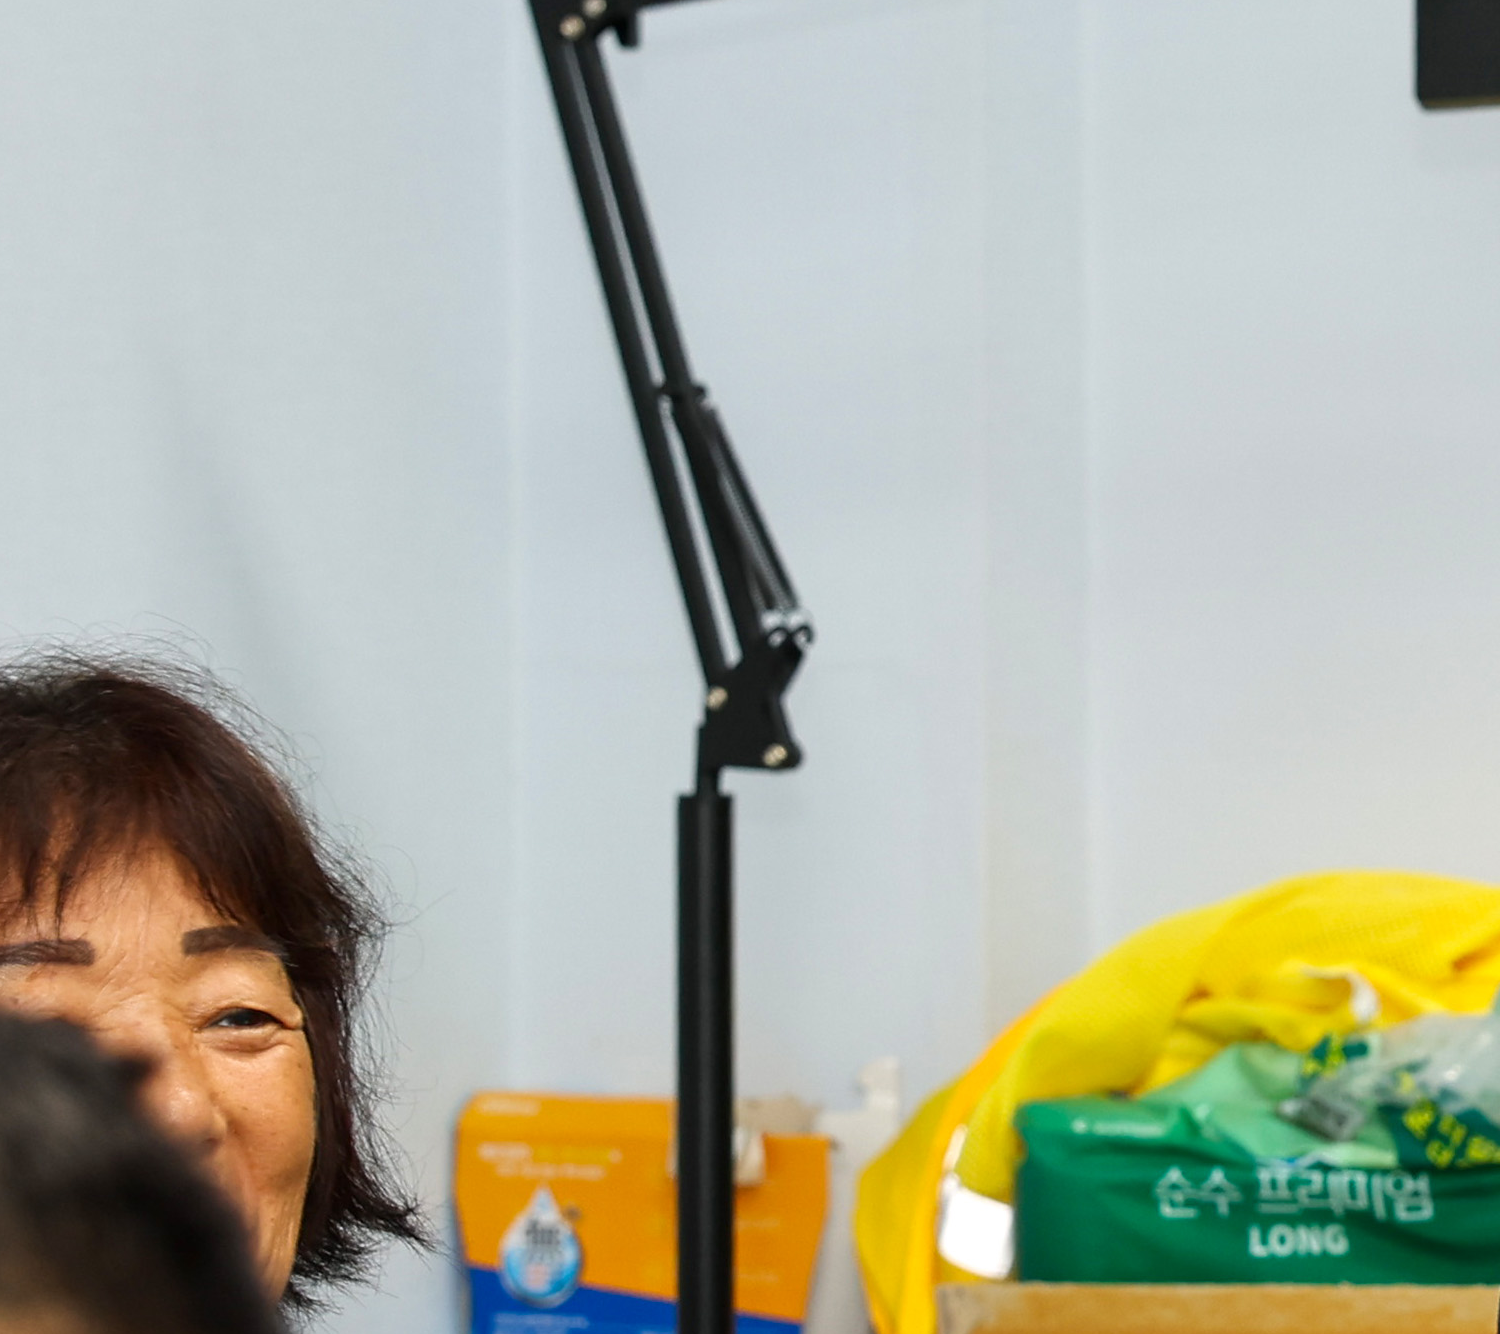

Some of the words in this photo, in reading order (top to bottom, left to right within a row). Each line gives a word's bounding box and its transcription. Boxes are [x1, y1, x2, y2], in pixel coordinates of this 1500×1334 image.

[1155, 1167, 1243, 1219] 순수
[1256, 1169, 1434, 1222] 프리미엄
[1248, 1223, 1350, 1258] LONG
